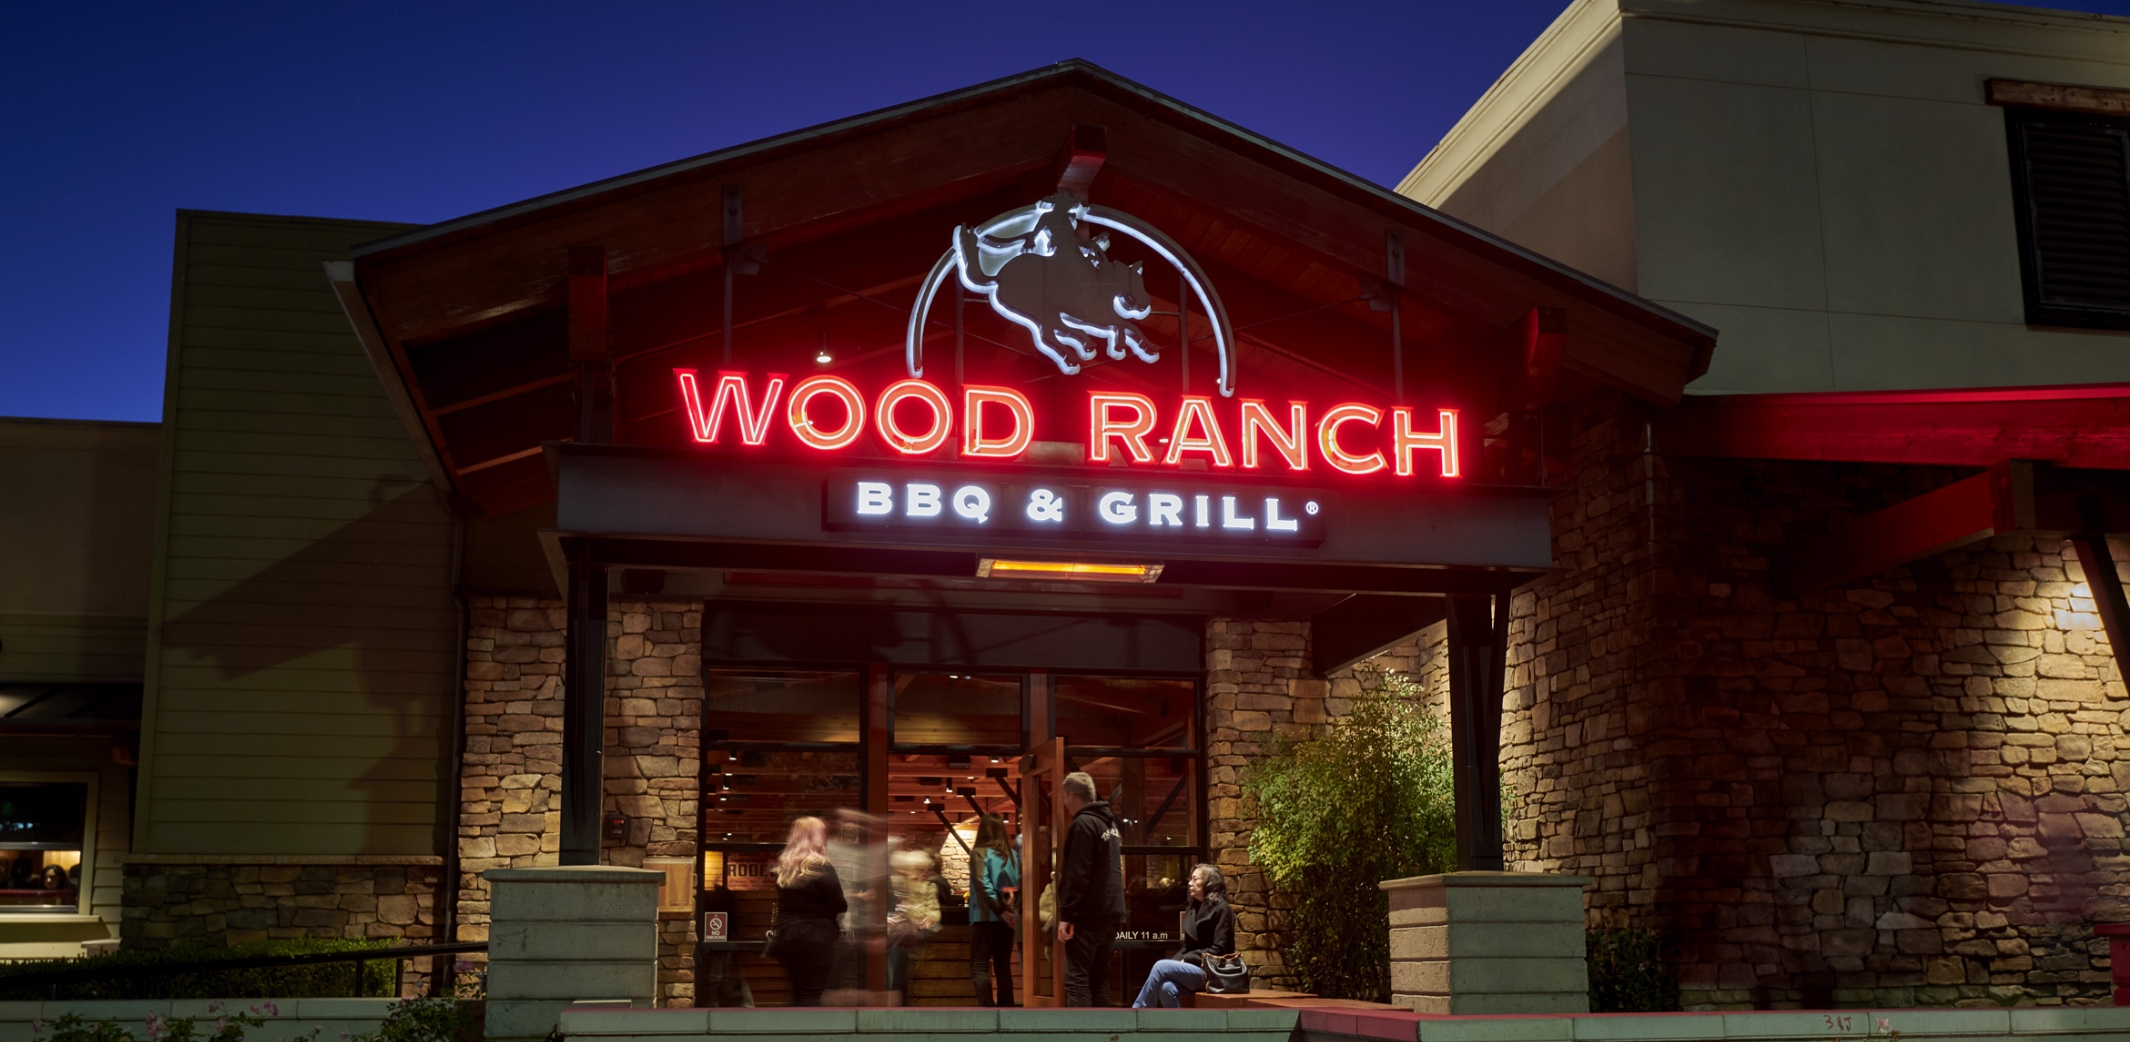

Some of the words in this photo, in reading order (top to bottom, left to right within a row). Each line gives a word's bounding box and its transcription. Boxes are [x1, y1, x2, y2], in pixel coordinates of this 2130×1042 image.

[673, 368, 1035, 458] WOOD
[1087, 391, 1462, 478] RANCH
[857, 482, 991, 524] BBQ
[1027, 489, 1063, 521] &
[1141, 931, 1150, 940] 11
